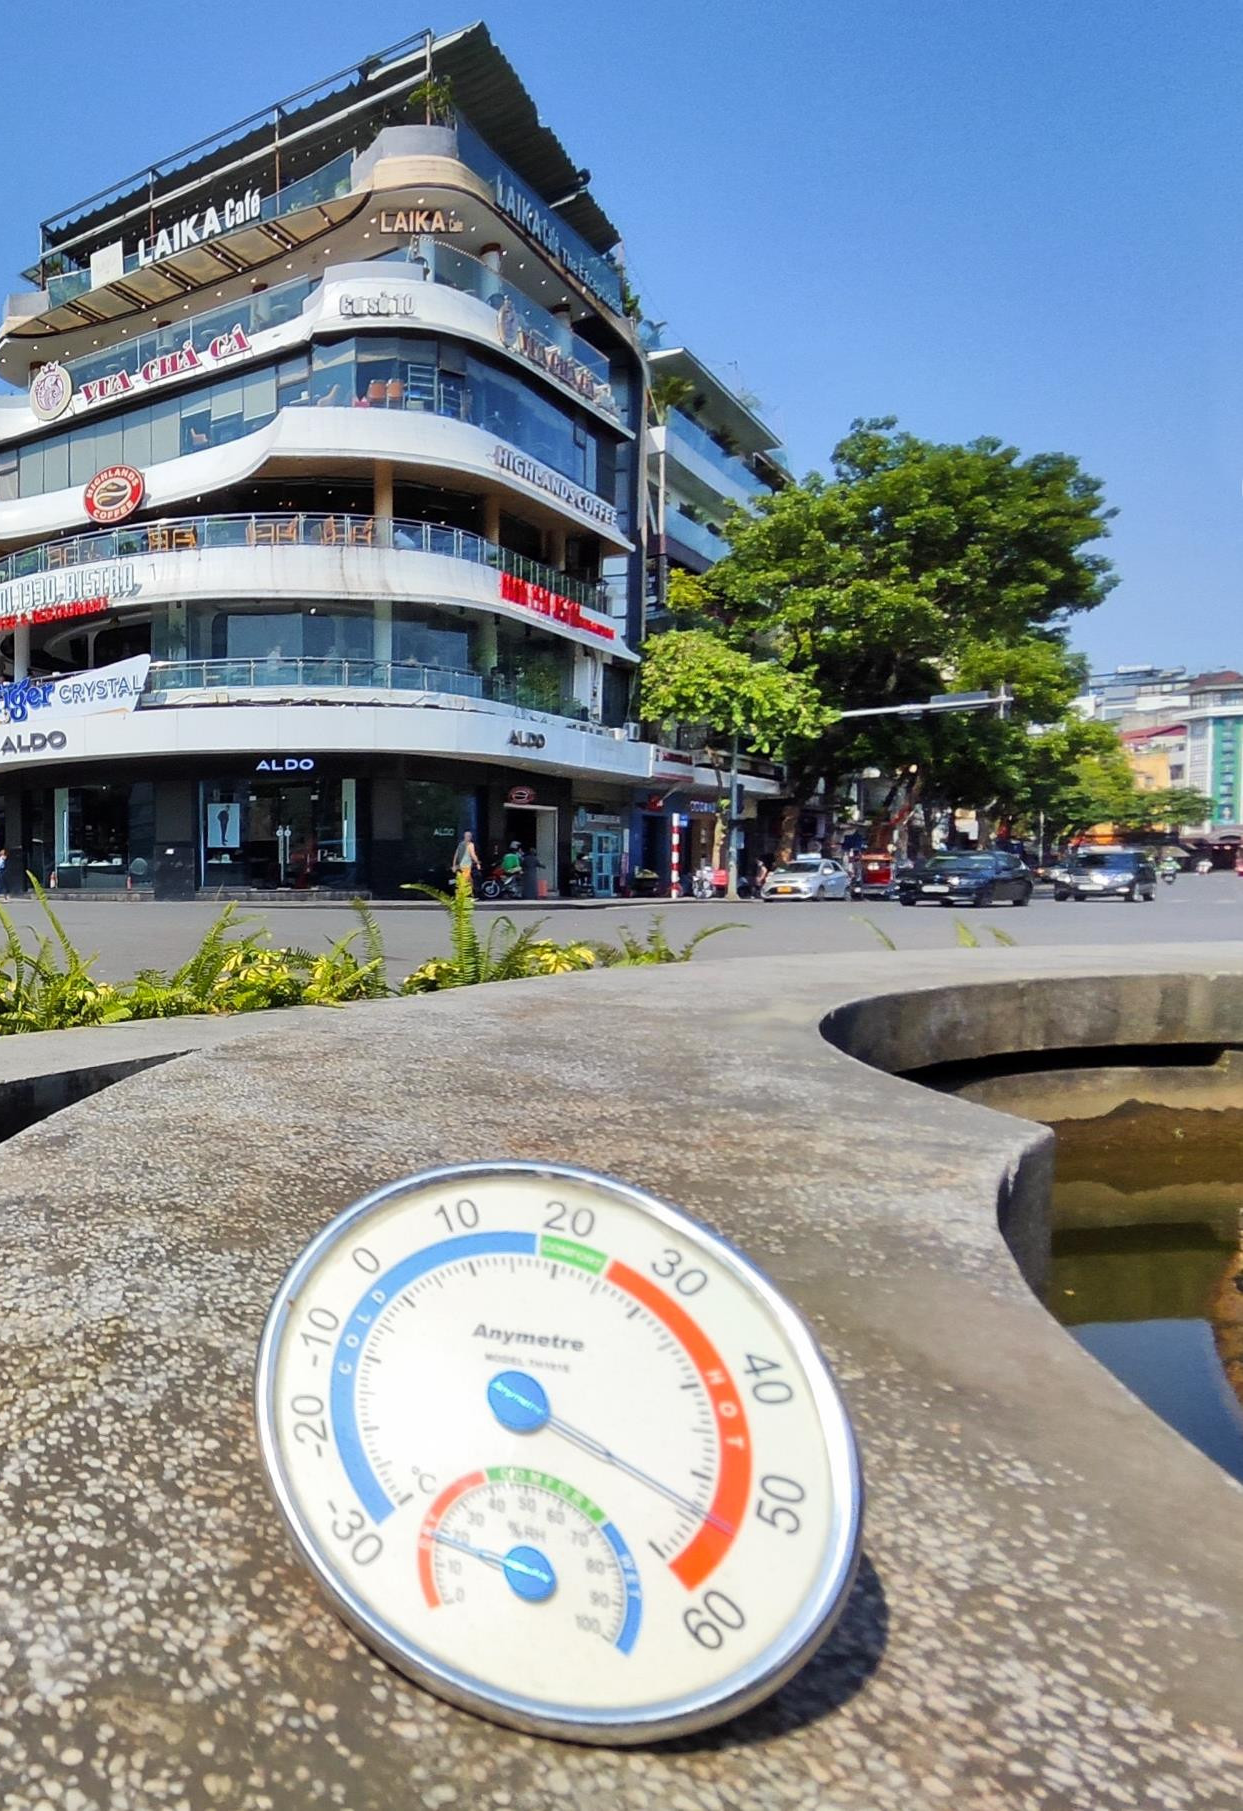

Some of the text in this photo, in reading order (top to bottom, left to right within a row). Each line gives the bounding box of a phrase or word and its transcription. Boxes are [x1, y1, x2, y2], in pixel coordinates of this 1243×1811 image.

[138, 187, 262, 266] LAIKA Café
[380, 210, 446, 233] LAIKA
[496, 174, 542, 242] LAIKA
[80, 370, 134, 403] VUA
[208, 323, 252, 360] CÁ
[86, 467, 140, 499] HIGHLANDS
[498, 446, 617, 526] HIGHLANDS COFFEE
[92, 500, 134, 519] COFFEE
[18, 576, 56, 609] 1930
[64, 563, 135, 600] BISTRO
[59, 675, 143, 703] CRYSTAL
[0, 731, 67, 755] ALDO
[508, 730, 547, 749] ALDO
[256, 758, 315, 771] ALDO
[434, 1197, 480, 1233] 10
[542, 1200, 596, 1238] 20
[352, 1247, 381, 1275] 0
[651, 1248, 709, 1297] 30
[299, 1307, 340, 1368] -10
[337, 1288, 387, 1376] COLD
[473, 1322, 585, 1352] Anymetre
[743, 1352, 794, 1405] 40
[290, 1394, 329, 1459] -20
[706, 1368, 746, 1451] HOT
[756, 1473, 807, 1535] 50
[327, 1499, 384, 1567] -30
[682, 1589, 746, 1651] 60
